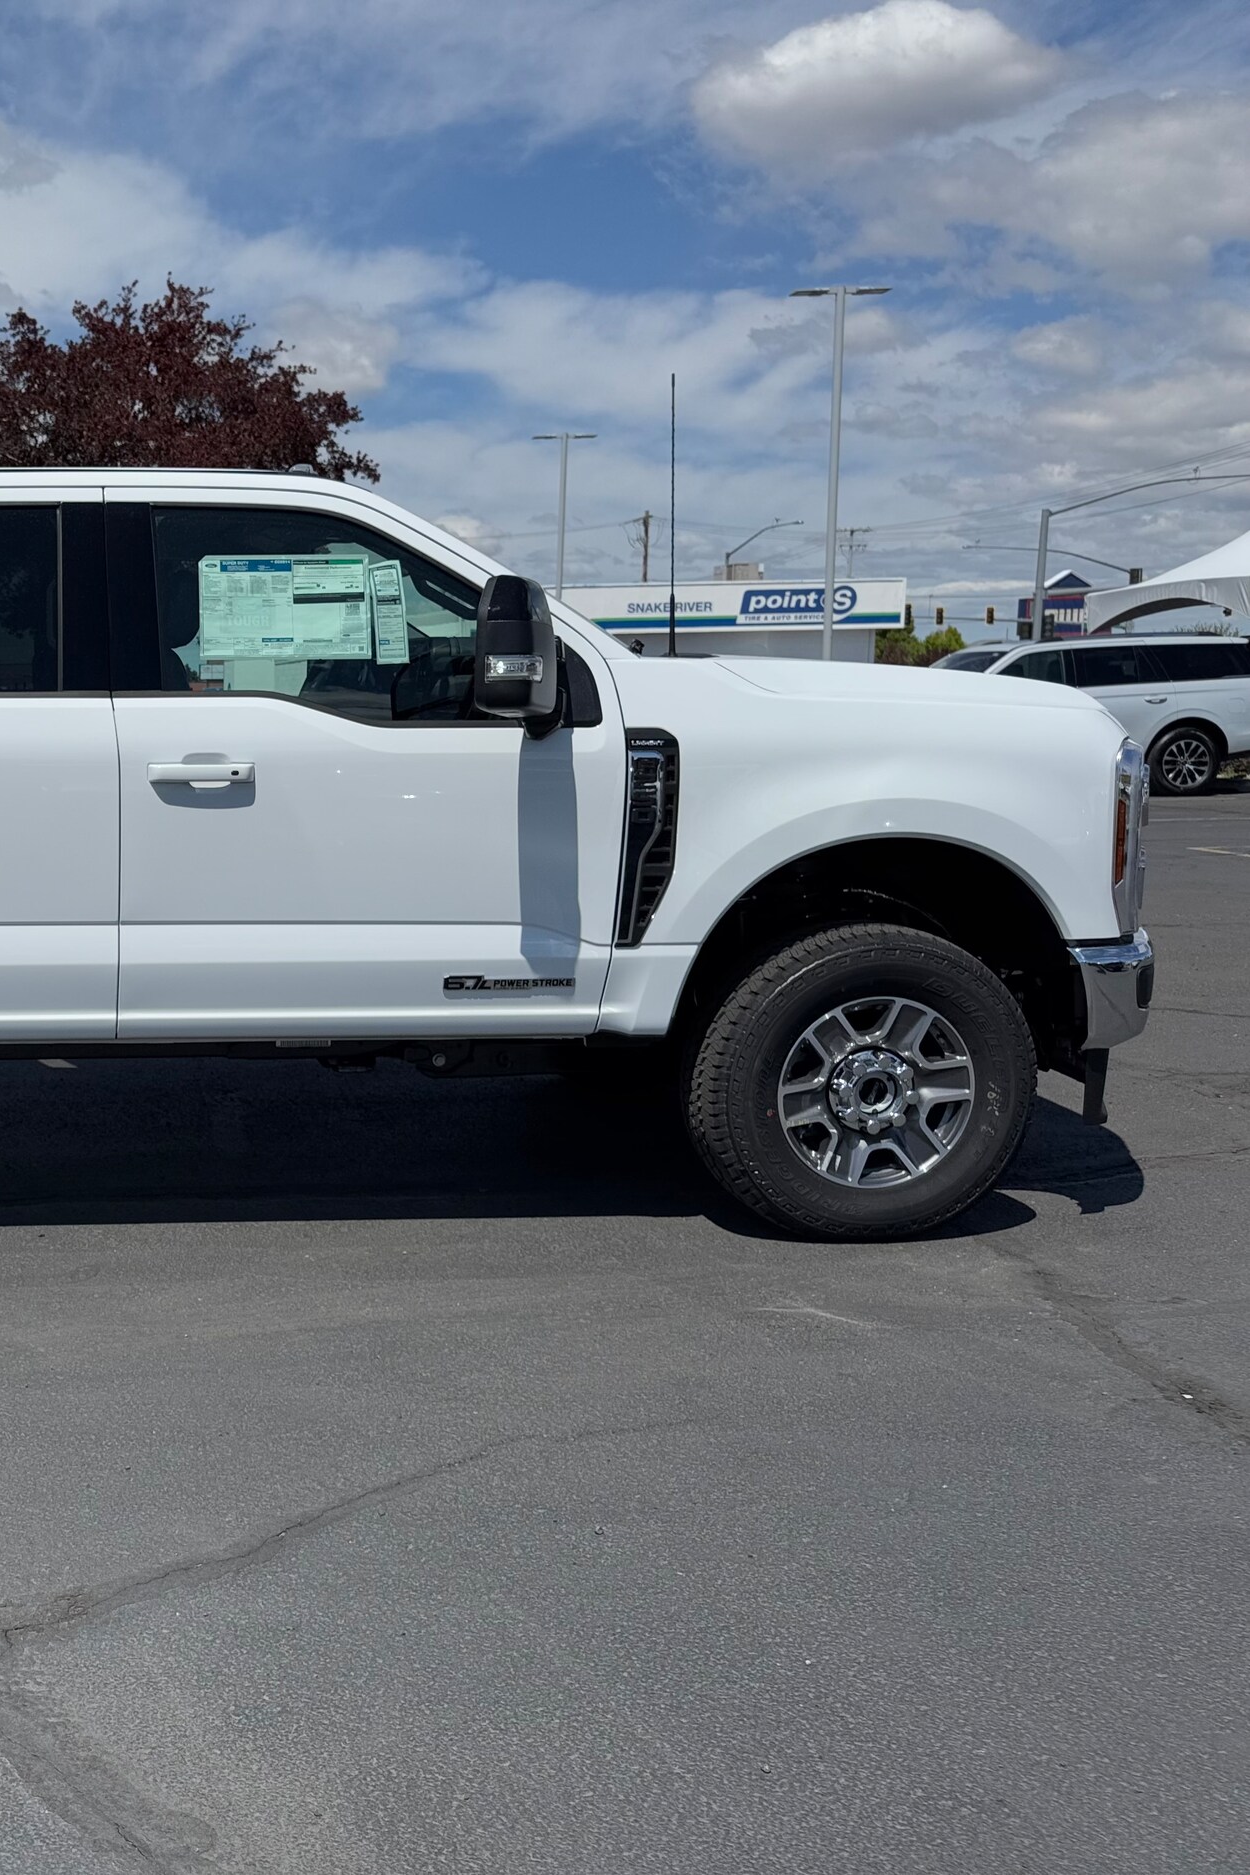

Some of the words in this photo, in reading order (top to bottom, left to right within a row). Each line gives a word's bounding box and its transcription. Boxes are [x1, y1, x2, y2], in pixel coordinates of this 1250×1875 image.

[748, 590, 816, 613] point
[832, 589, 853, 611] S
[627, 603, 670, 614] SNAKE
[675, 602, 713, 613] RIVER
[493, 979, 530, 988] POWER
[531, 978, 573, 987] STROKE
